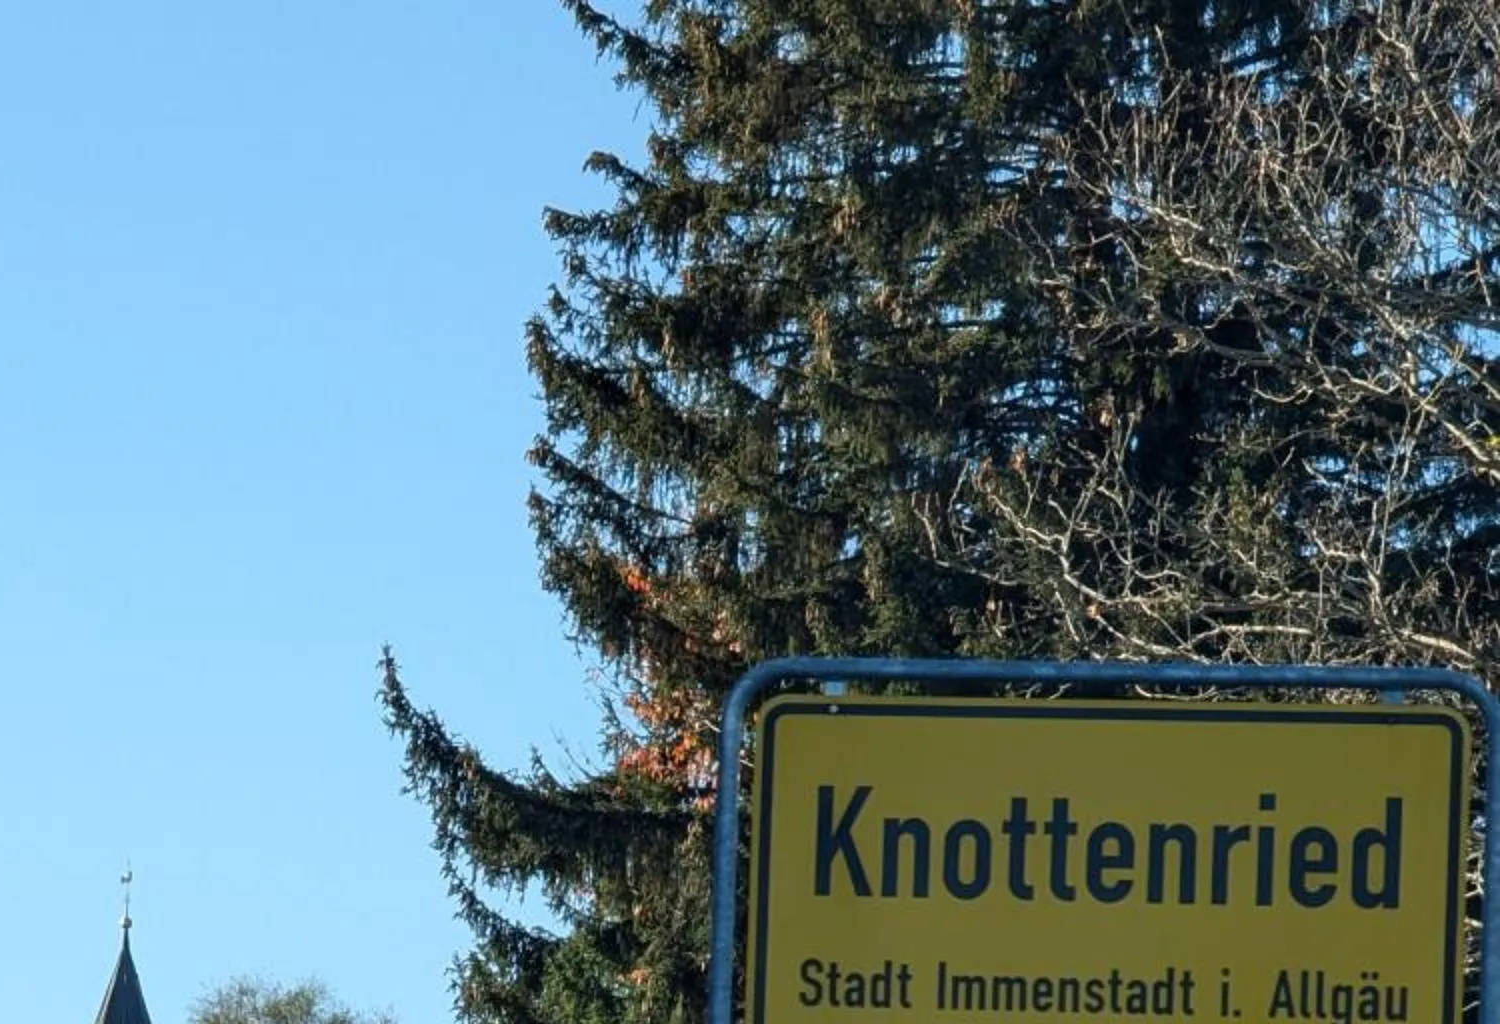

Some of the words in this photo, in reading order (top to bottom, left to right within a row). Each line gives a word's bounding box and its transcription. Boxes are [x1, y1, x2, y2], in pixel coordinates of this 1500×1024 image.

[813, 784, 1404, 910] Knottenried
[799, 958, 913, 1010] Stadt
[938, 961, 1196, 1017] Immenstadt
[1220, 968, 1242, 1018] i.
